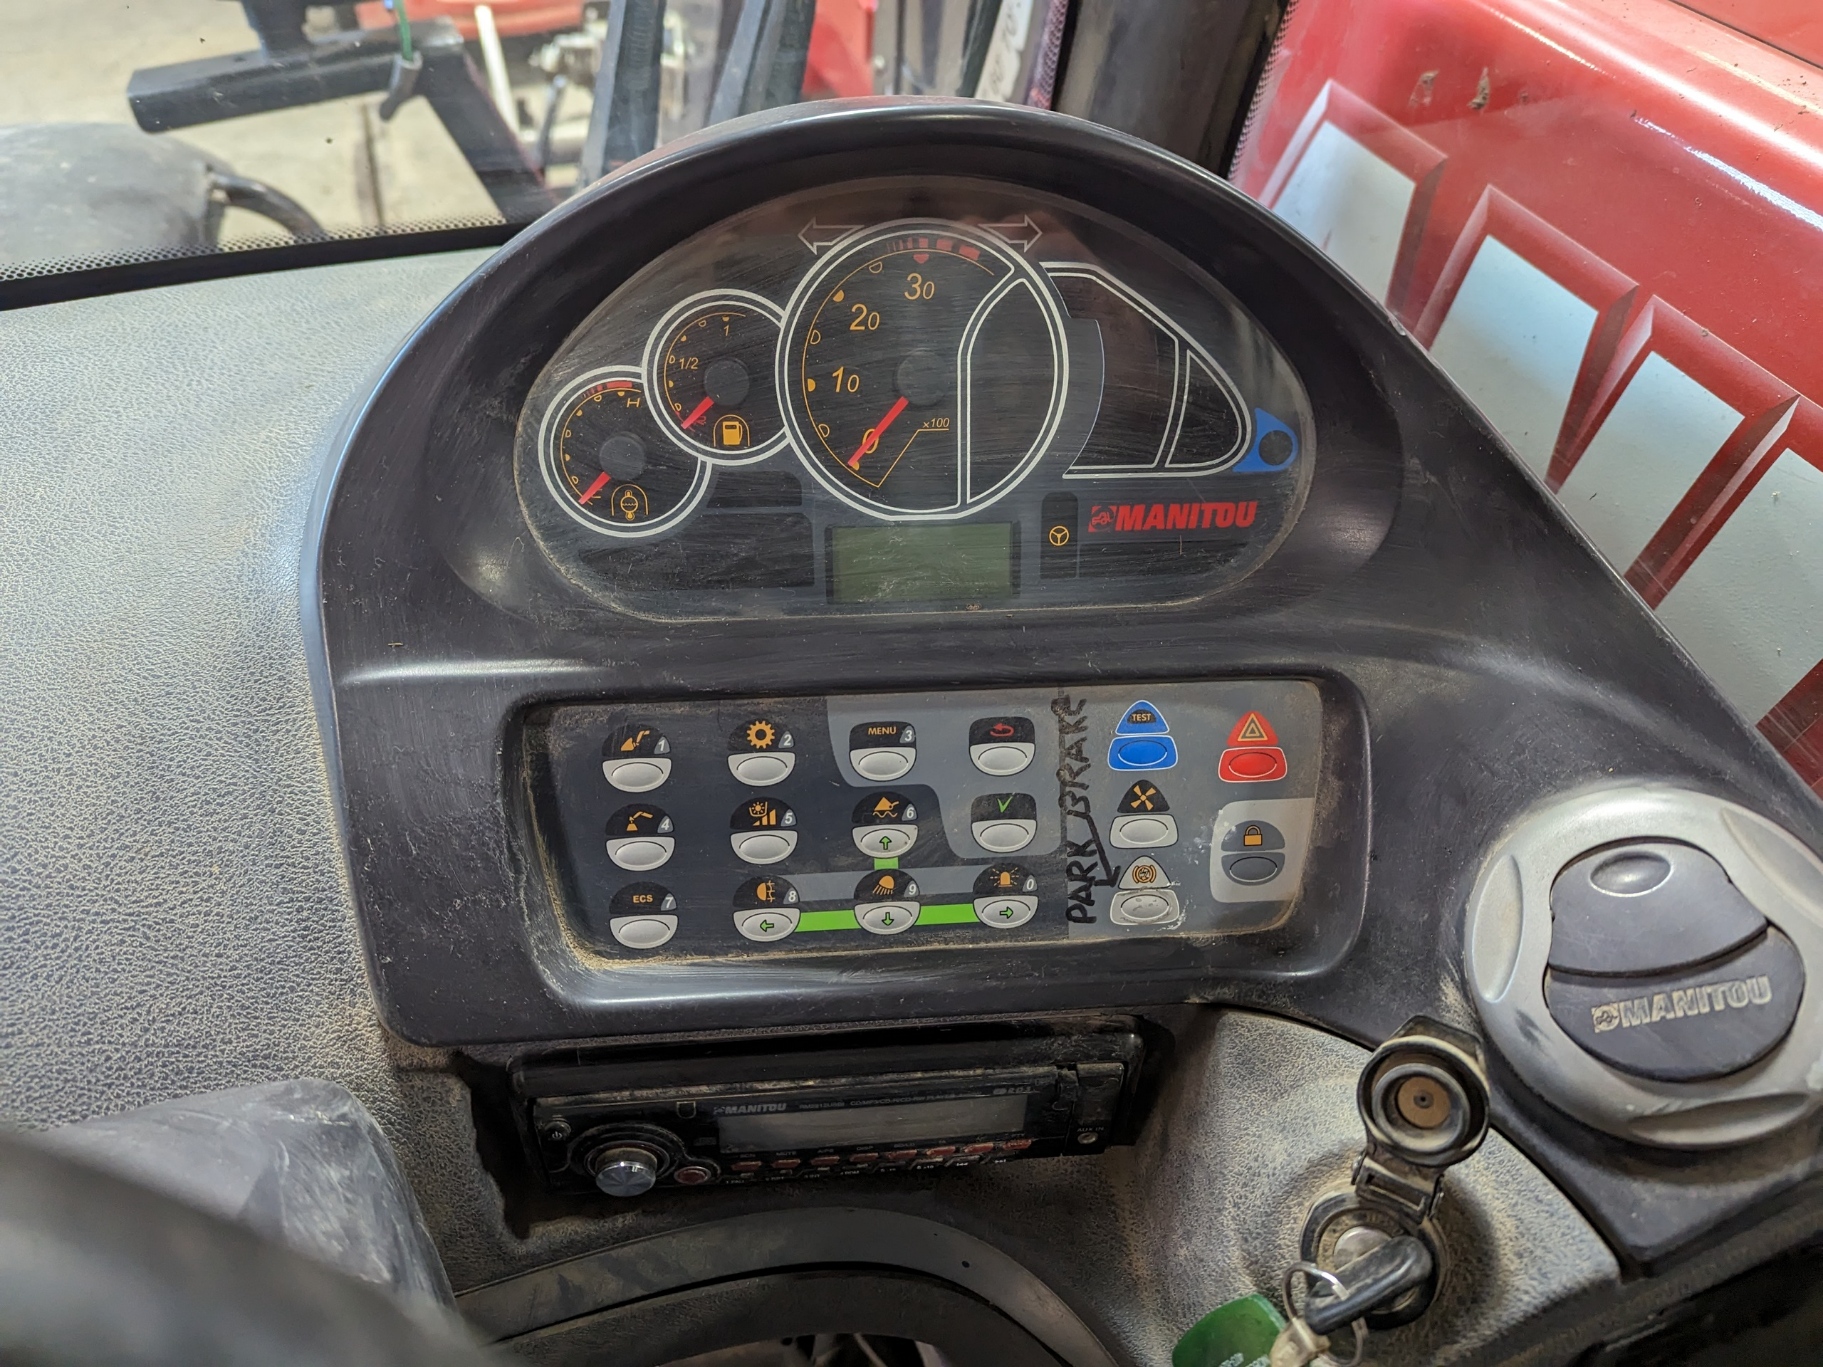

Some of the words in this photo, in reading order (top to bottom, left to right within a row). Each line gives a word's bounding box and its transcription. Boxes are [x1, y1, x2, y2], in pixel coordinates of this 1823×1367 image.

[904, 272, 935, 300] 30
[850, 303, 880, 331] 20
[723, 324, 730, 337] 1
[679, 356, 699, 370] 1/2
[831, 366, 860, 393] 10
[1115, 501, 1258, 531] MANITOU
[1131, 711, 1152, 722] TEST
[868, 726, 897, 736] MENU
[904, 729, 913, 742] 3
[658, 739, 667, 752] 1
[783, 733, 792, 747] 2
[784, 810, 793, 825] 5
[906, 806, 915, 819] 6
[660, 818, 671, 832] 4
[1026, 878, 1035, 892] 0
[1065, 838, 1099, 925] PARK
[908, 883, 917, 896] 9
[632, 894, 653, 904] ECS
[665, 896, 675, 909] 7
[787, 890, 797, 904] 8
[1618, 975, 1773, 1028] MANITOU
[724, 1102, 787, 1115] MANITOU
